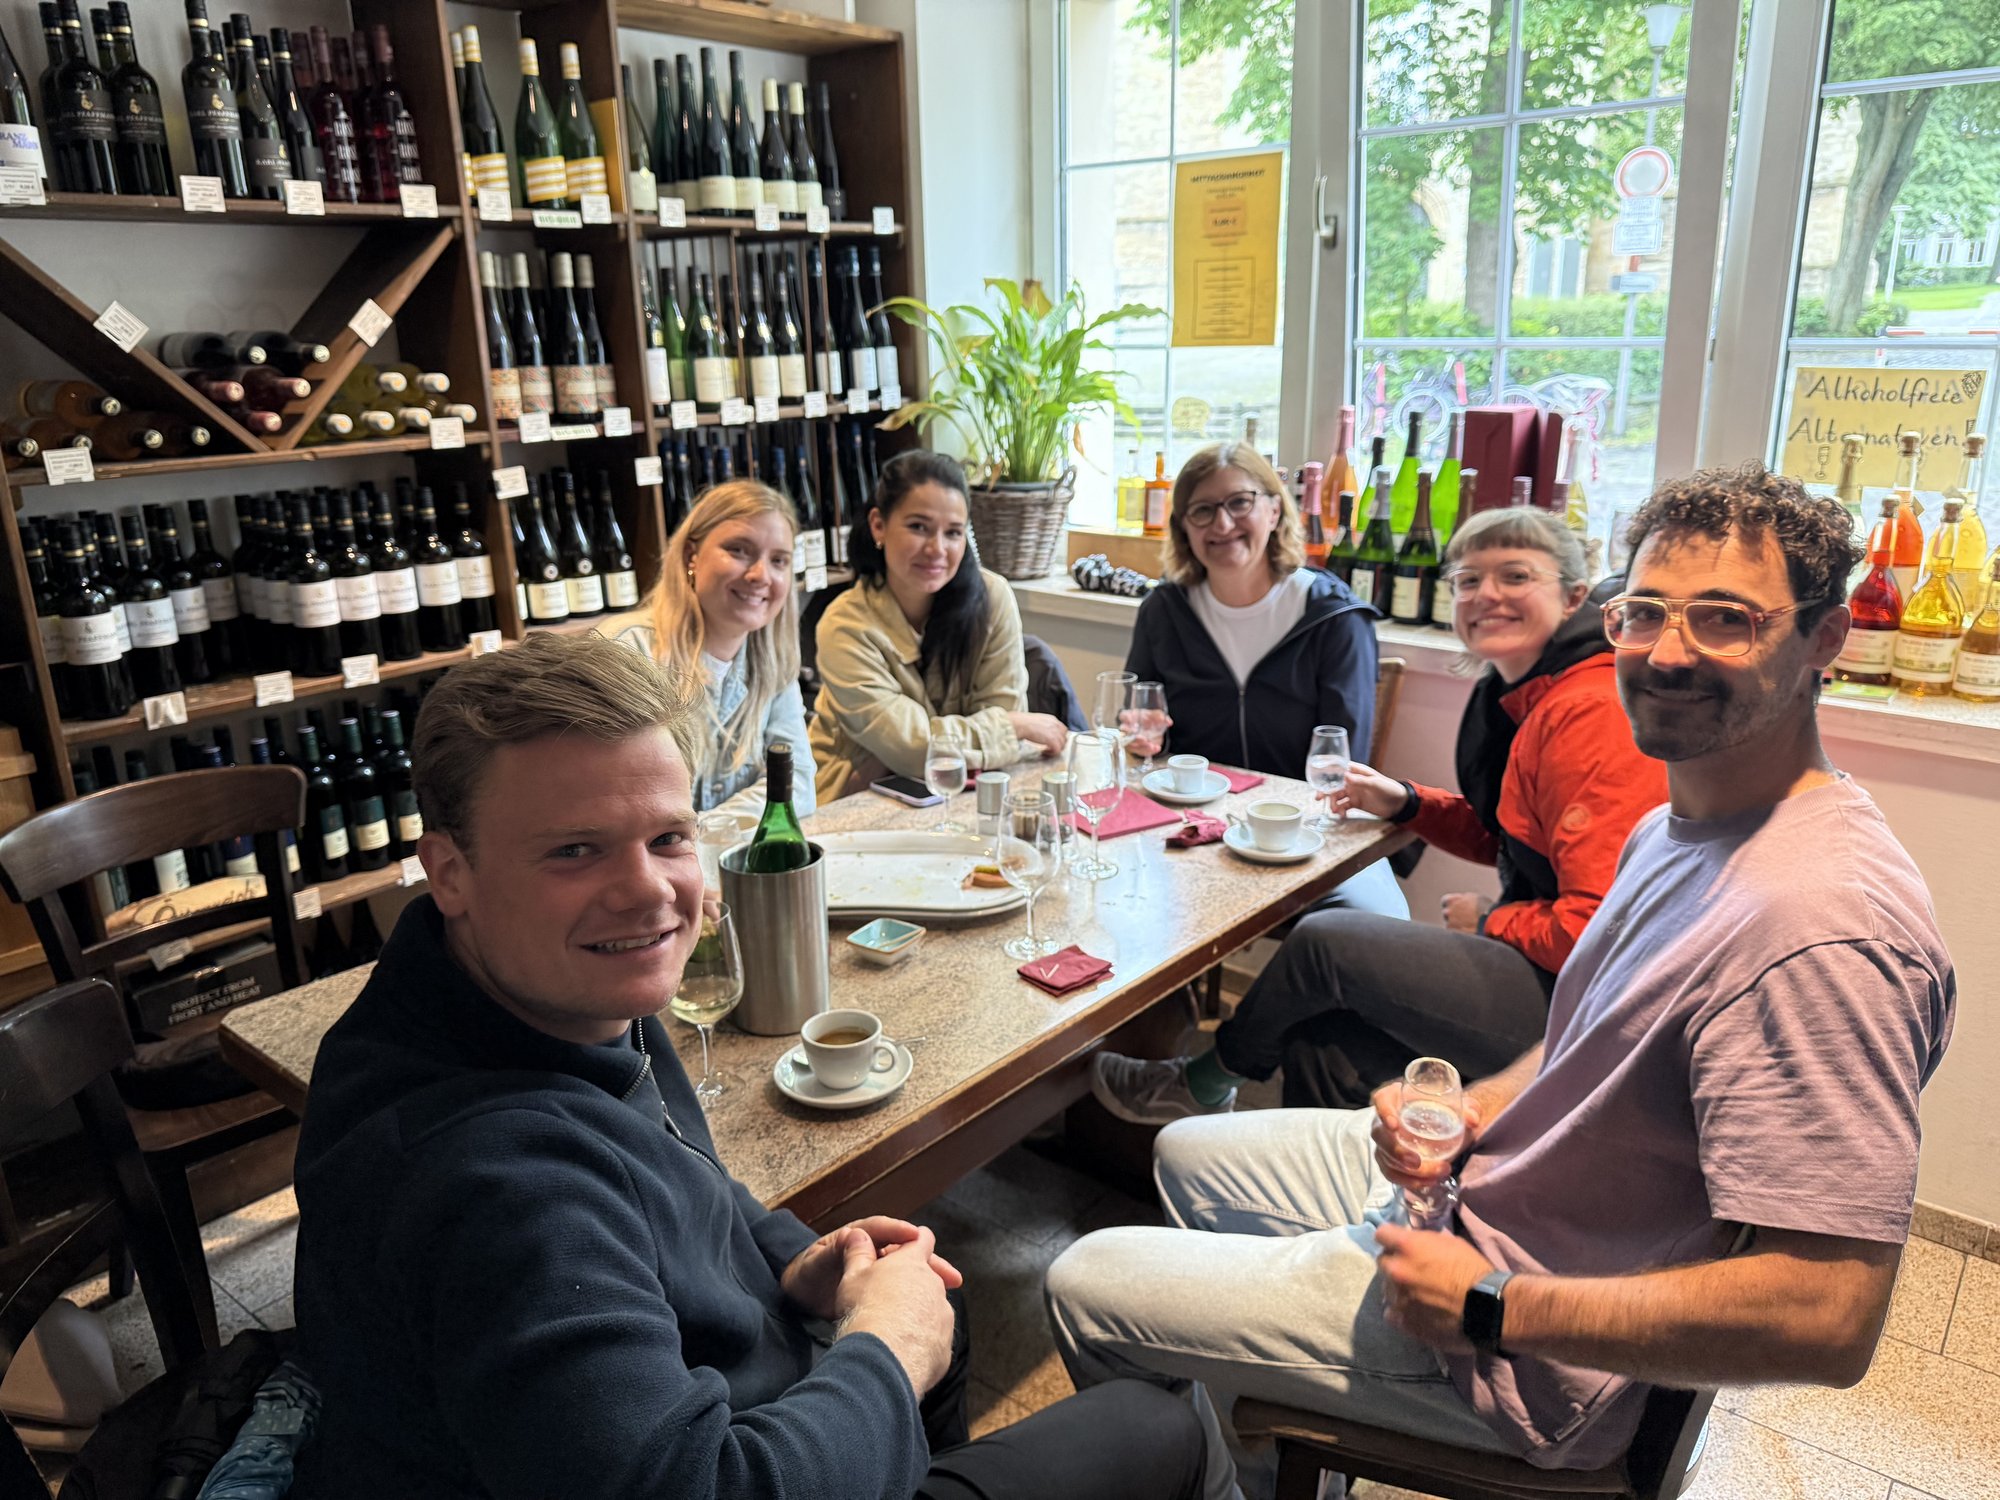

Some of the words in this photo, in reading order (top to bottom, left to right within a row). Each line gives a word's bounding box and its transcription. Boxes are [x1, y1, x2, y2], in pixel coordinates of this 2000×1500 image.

[1805, 375, 1964, 408] Alkoholfreie
[168, 1005, 204, 1026] FROST
[205, 995, 232, 1013] AND
[170, 987, 221, 1013] PROTECT
[223, 976, 256, 994] FROM
